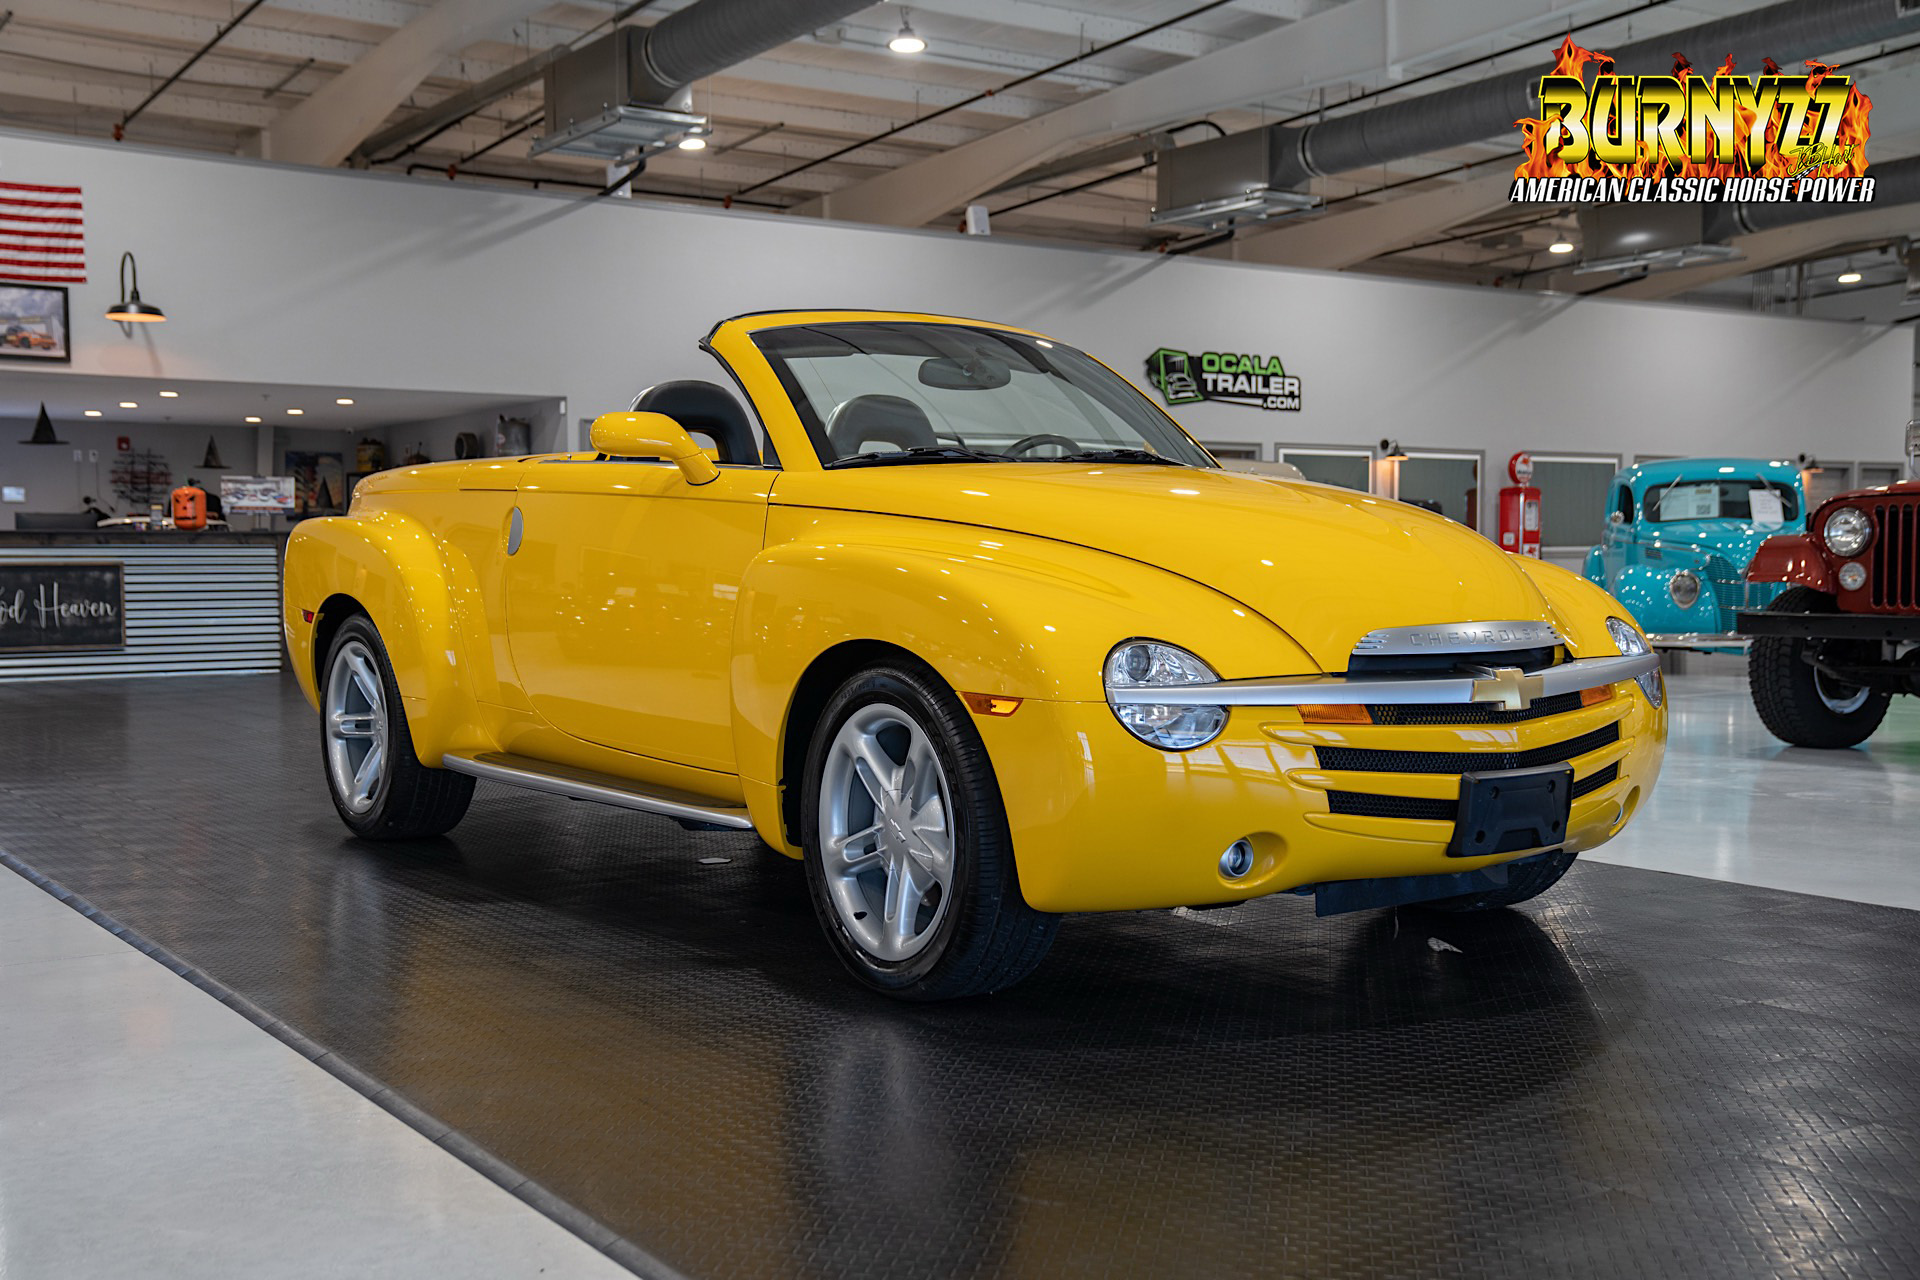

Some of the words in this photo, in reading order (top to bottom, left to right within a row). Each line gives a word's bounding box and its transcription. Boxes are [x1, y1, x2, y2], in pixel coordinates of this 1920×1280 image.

[1202, 352, 1284, 376] OCALA
[1202, 373, 1300, 396] TRAILER
[1263, 396, 1300, 410] .COM
[33, 581, 117, 629] Heaven
[1409, 627, 1543, 647] CHEVROLET
